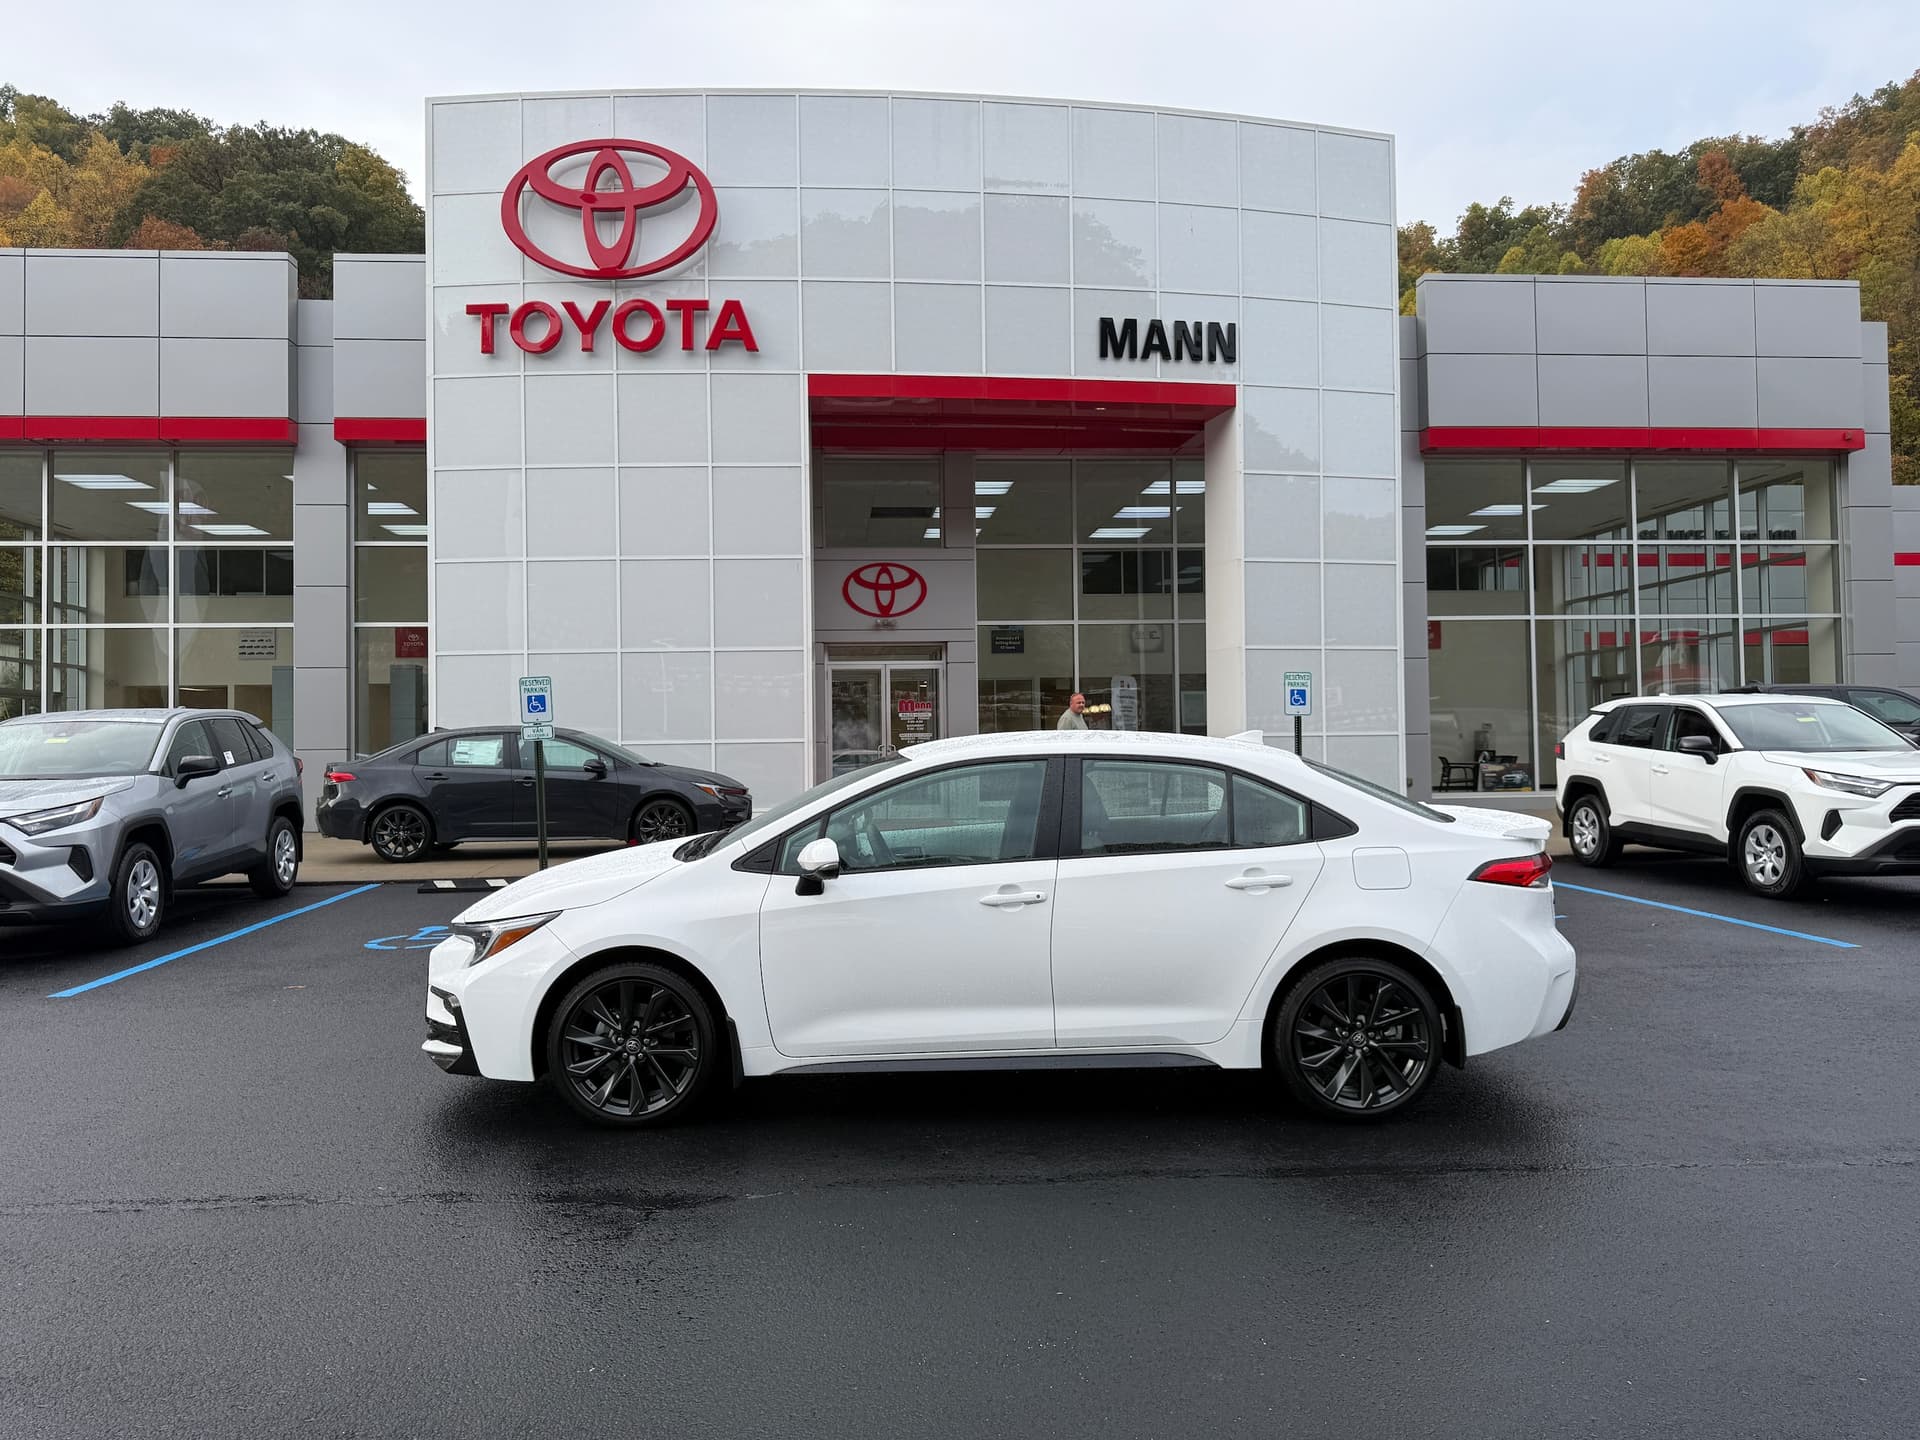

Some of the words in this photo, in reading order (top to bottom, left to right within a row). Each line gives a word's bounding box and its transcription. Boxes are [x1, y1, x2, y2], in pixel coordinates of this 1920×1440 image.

[466, 299, 759, 354] TOYOTA
[1099, 317, 1237, 363] MANN
[521, 679, 550, 687] RESERVED
